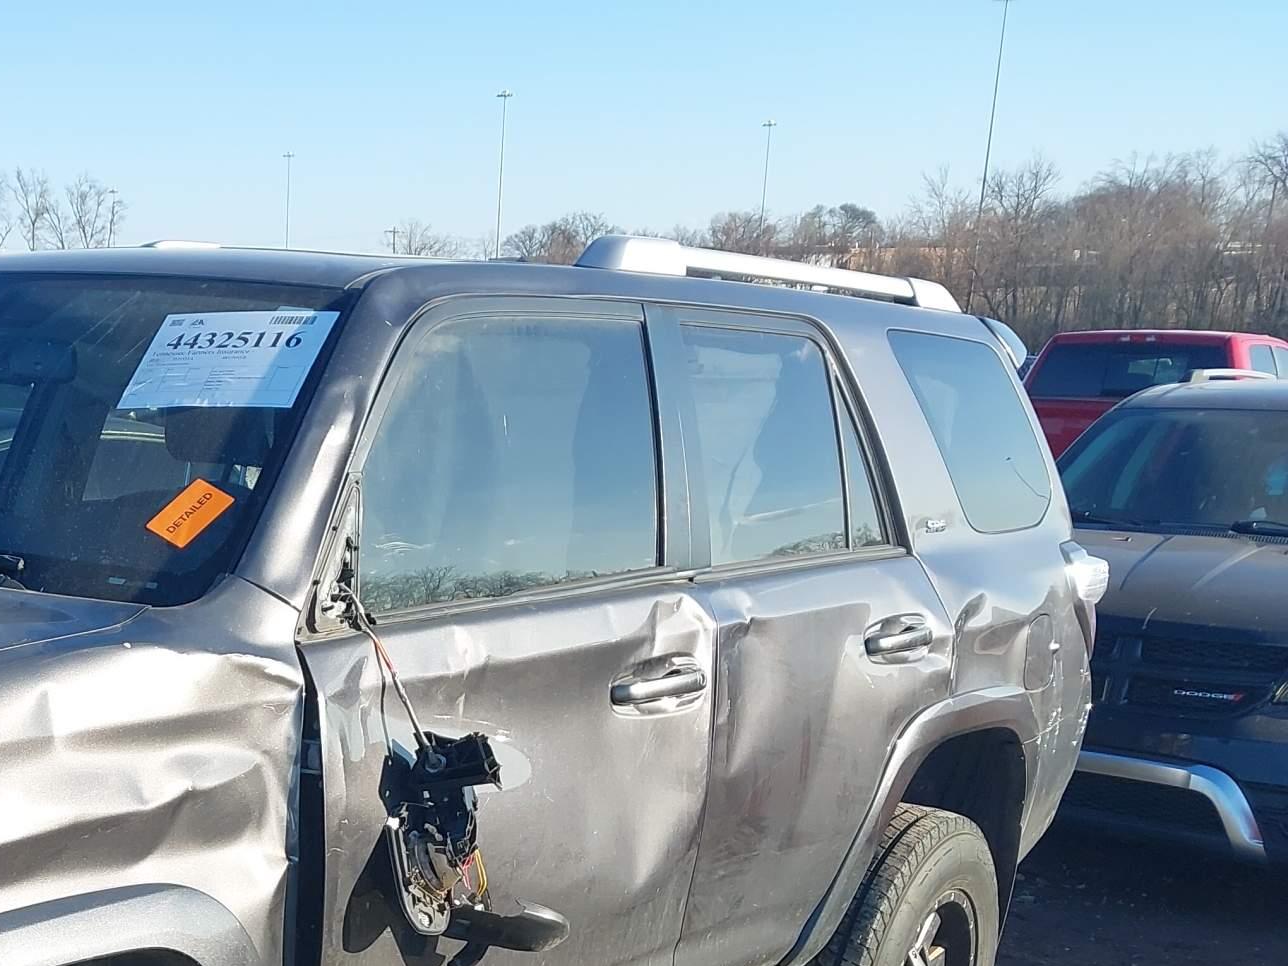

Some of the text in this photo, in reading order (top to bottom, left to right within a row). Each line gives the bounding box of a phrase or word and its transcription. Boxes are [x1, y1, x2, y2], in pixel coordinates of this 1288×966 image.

[166, 330, 309, 351] 44325116
[166, 492, 213, 534] DETAILED
[1173, 689, 1234, 701] DODGE
